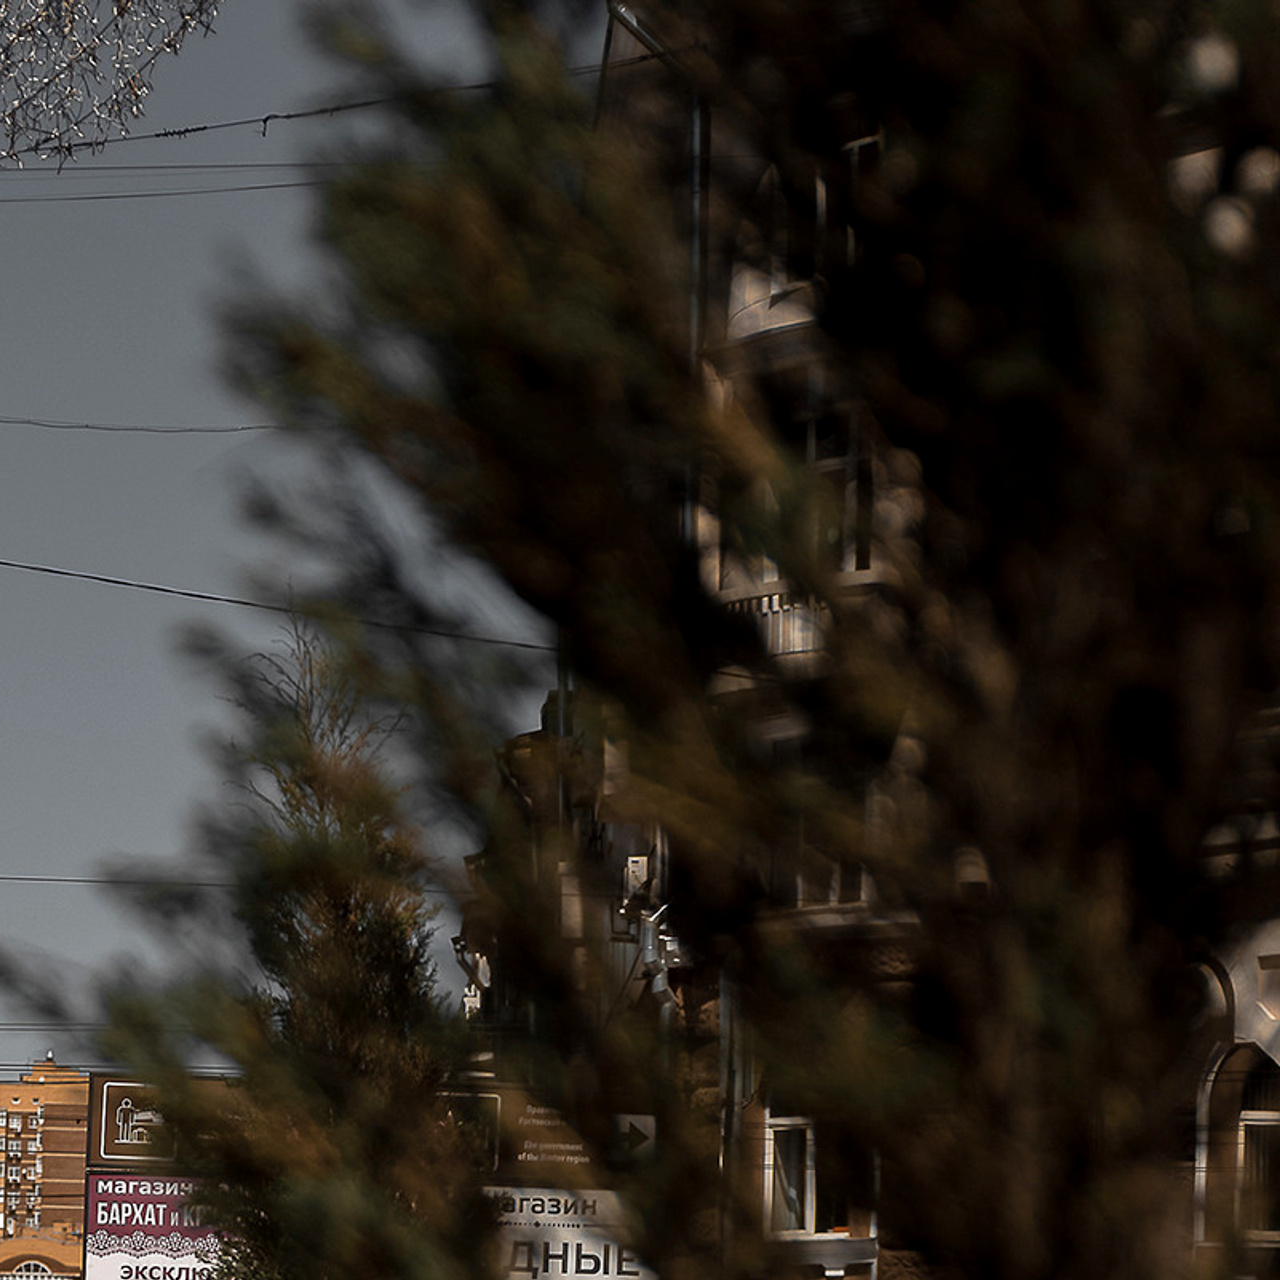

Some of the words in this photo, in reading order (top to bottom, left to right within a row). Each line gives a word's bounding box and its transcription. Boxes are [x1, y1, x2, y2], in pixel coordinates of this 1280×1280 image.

[97, 1202, 167, 1226] БАРХАТ
[170, 1211, 179, 1227] и
[503, 1197, 597, 1216] агазин
[505, 1240, 640, 1280] ДНЫЕ
[120, 1265, 211, 1280] ЭКСКЛЮ
